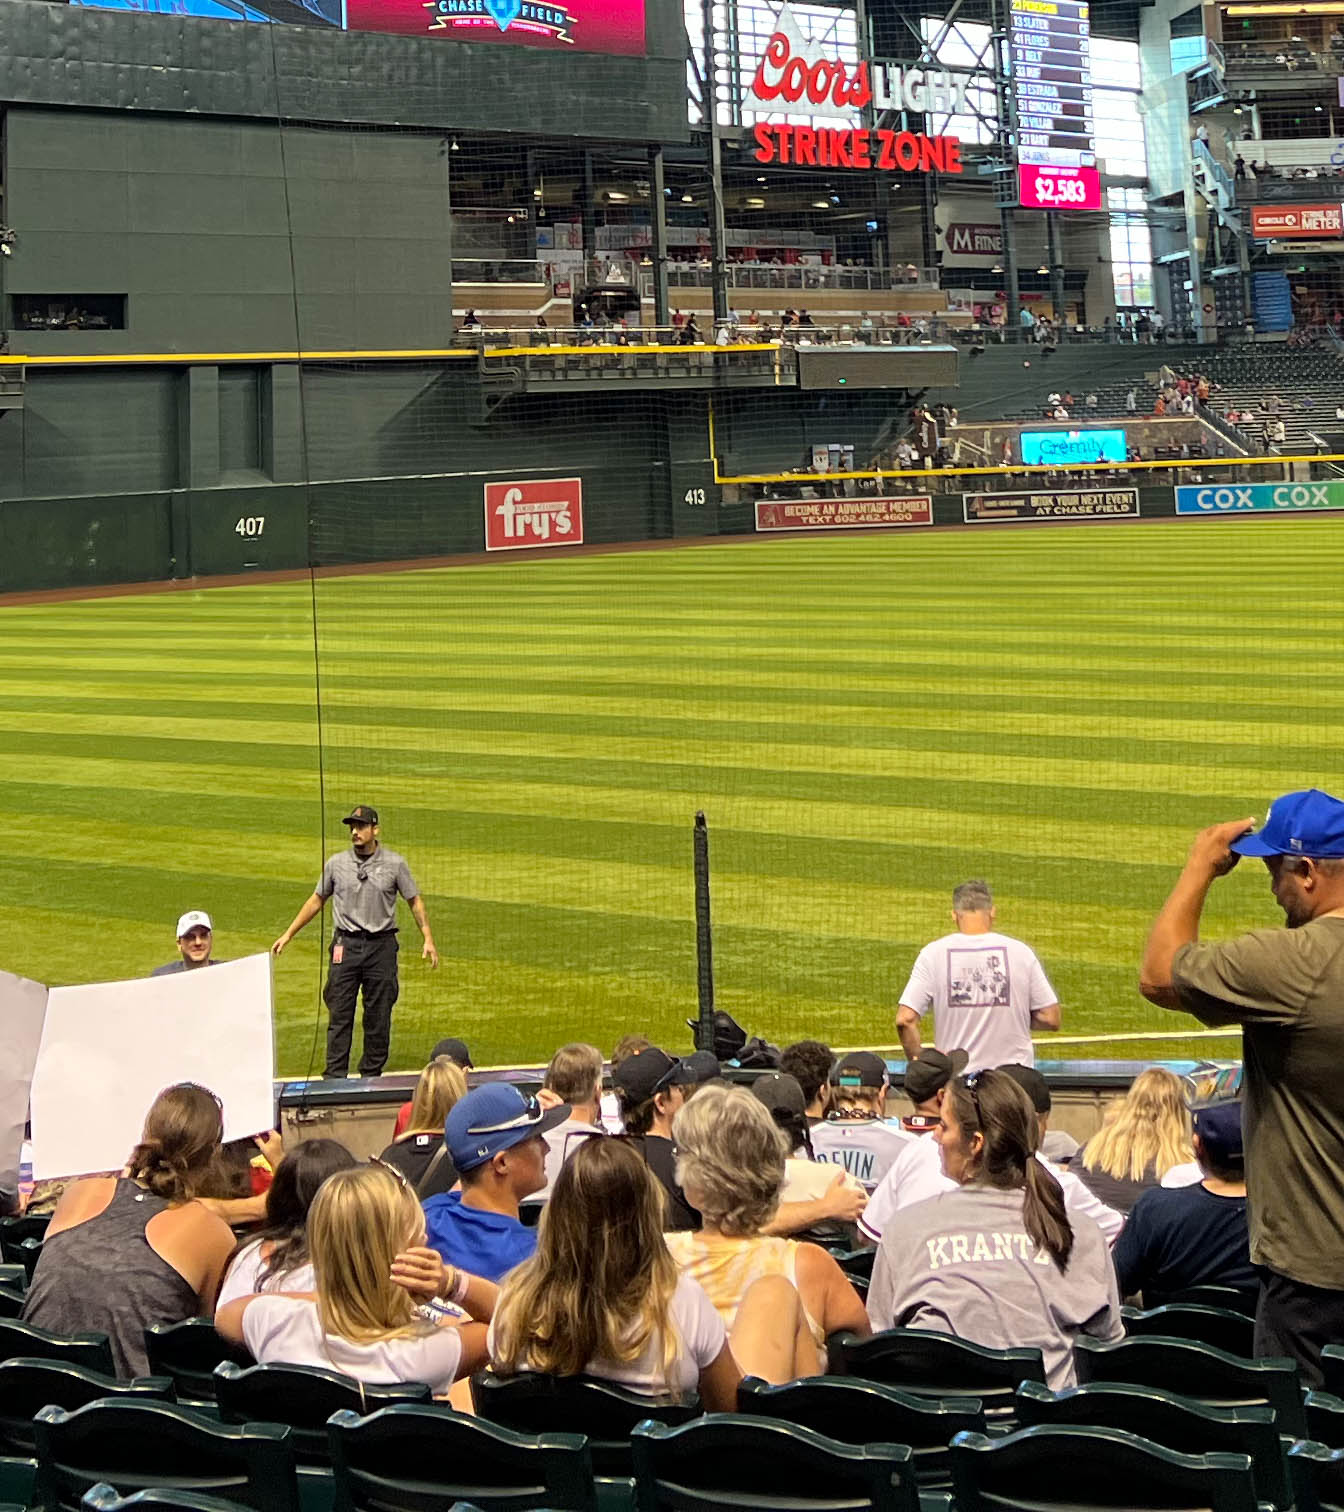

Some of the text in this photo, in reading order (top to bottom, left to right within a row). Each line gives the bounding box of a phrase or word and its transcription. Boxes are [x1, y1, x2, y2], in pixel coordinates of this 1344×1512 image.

[439, 0, 564, 25] CHASE FIELD
[753, 32, 971, 114] Coors LIGHT
[754, 123, 963, 175] STRIKE ZONE
[1035, 177, 1086, 205] $2,583
[1302, 216, 1341, 232] METER
[685, 489, 705, 506] 413
[1056, 492, 1134, 506] YOUR NEXT EVENT
[1197, 486, 1329, 510] COX COX
[496, 488, 572, 540] fry's
[784, 500, 928, 517] BECOME AN ADVANTAGE MEMBER
[1036, 503, 1130, 515] AT CHASE FIELD
[235, 517, 265, 536] 407
[801, 515, 832, 524] TEXT
[927, 1232, 1050, 1269] KRANTZ
